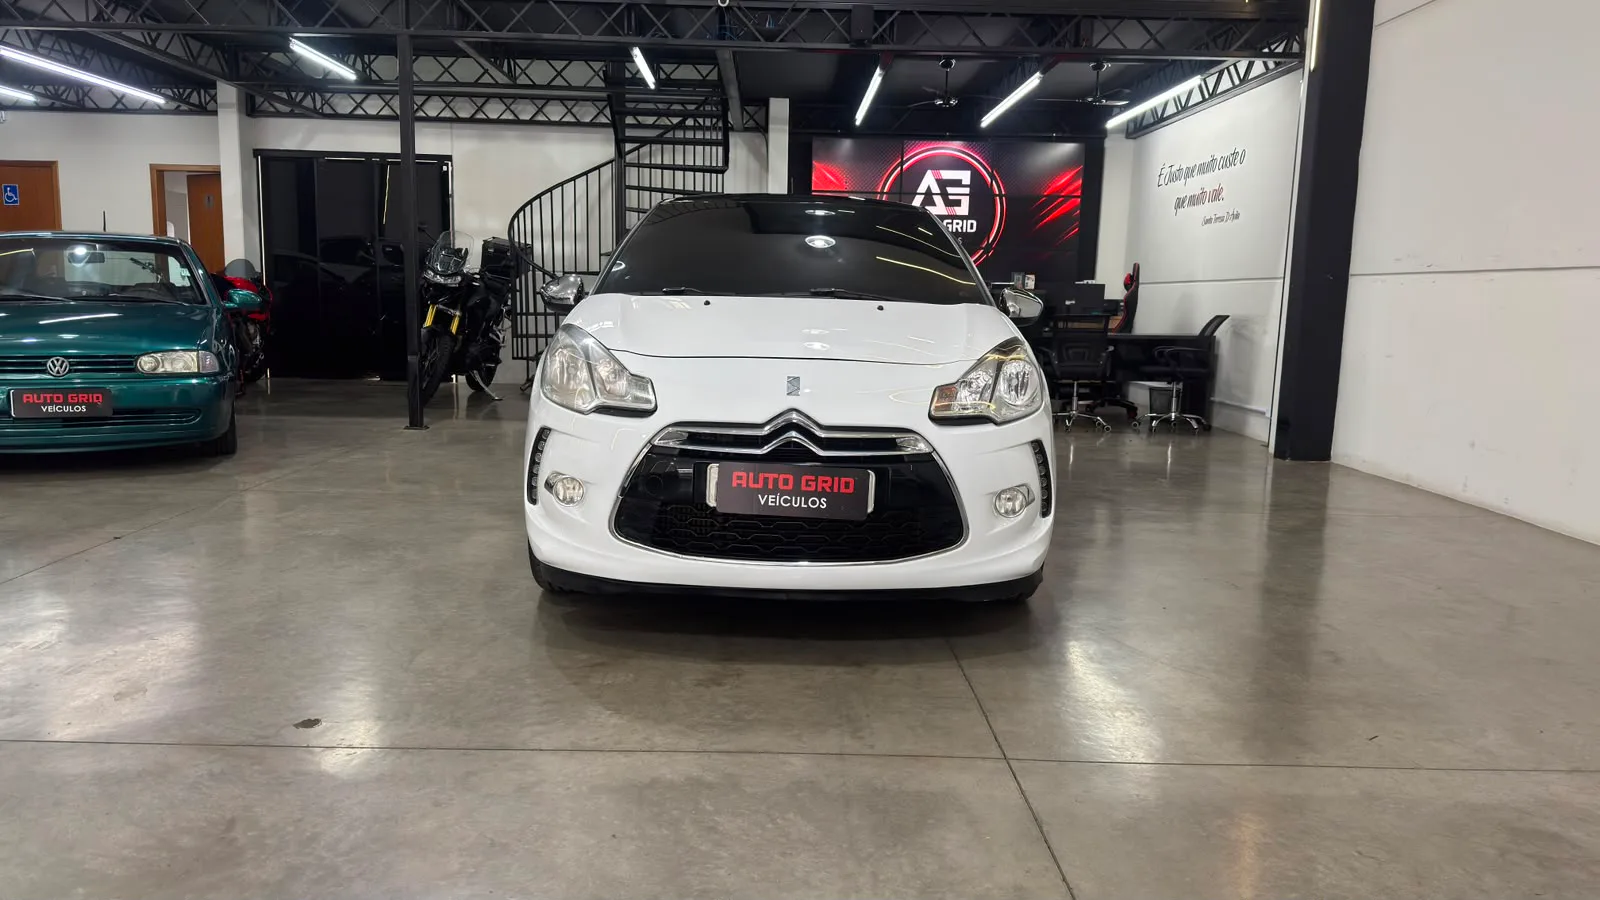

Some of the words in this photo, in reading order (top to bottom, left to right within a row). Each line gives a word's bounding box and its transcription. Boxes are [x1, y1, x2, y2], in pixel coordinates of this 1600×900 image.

[1164, 164, 1184, 186] Justo
[1184, 164, 1197, 187] que
[1197, 154, 1218, 175] muito
[1218, 147, 1239, 171] custe
[1239, 149, 1246, 165] o
[1174, 195, 1187, 216] que
[1187, 187, 1207, 208] muito
[943, 220, 977, 232] GRID
[23, 394, 63, 403] AUTO
[68, 394, 103, 403] GRID
[41, 404, 87, 413] VEÍCULOS
[732, 471, 794, 491] AUTO
[801, 475, 855, 494] GRID
[758, 492, 828, 509] VEÍCULOS
